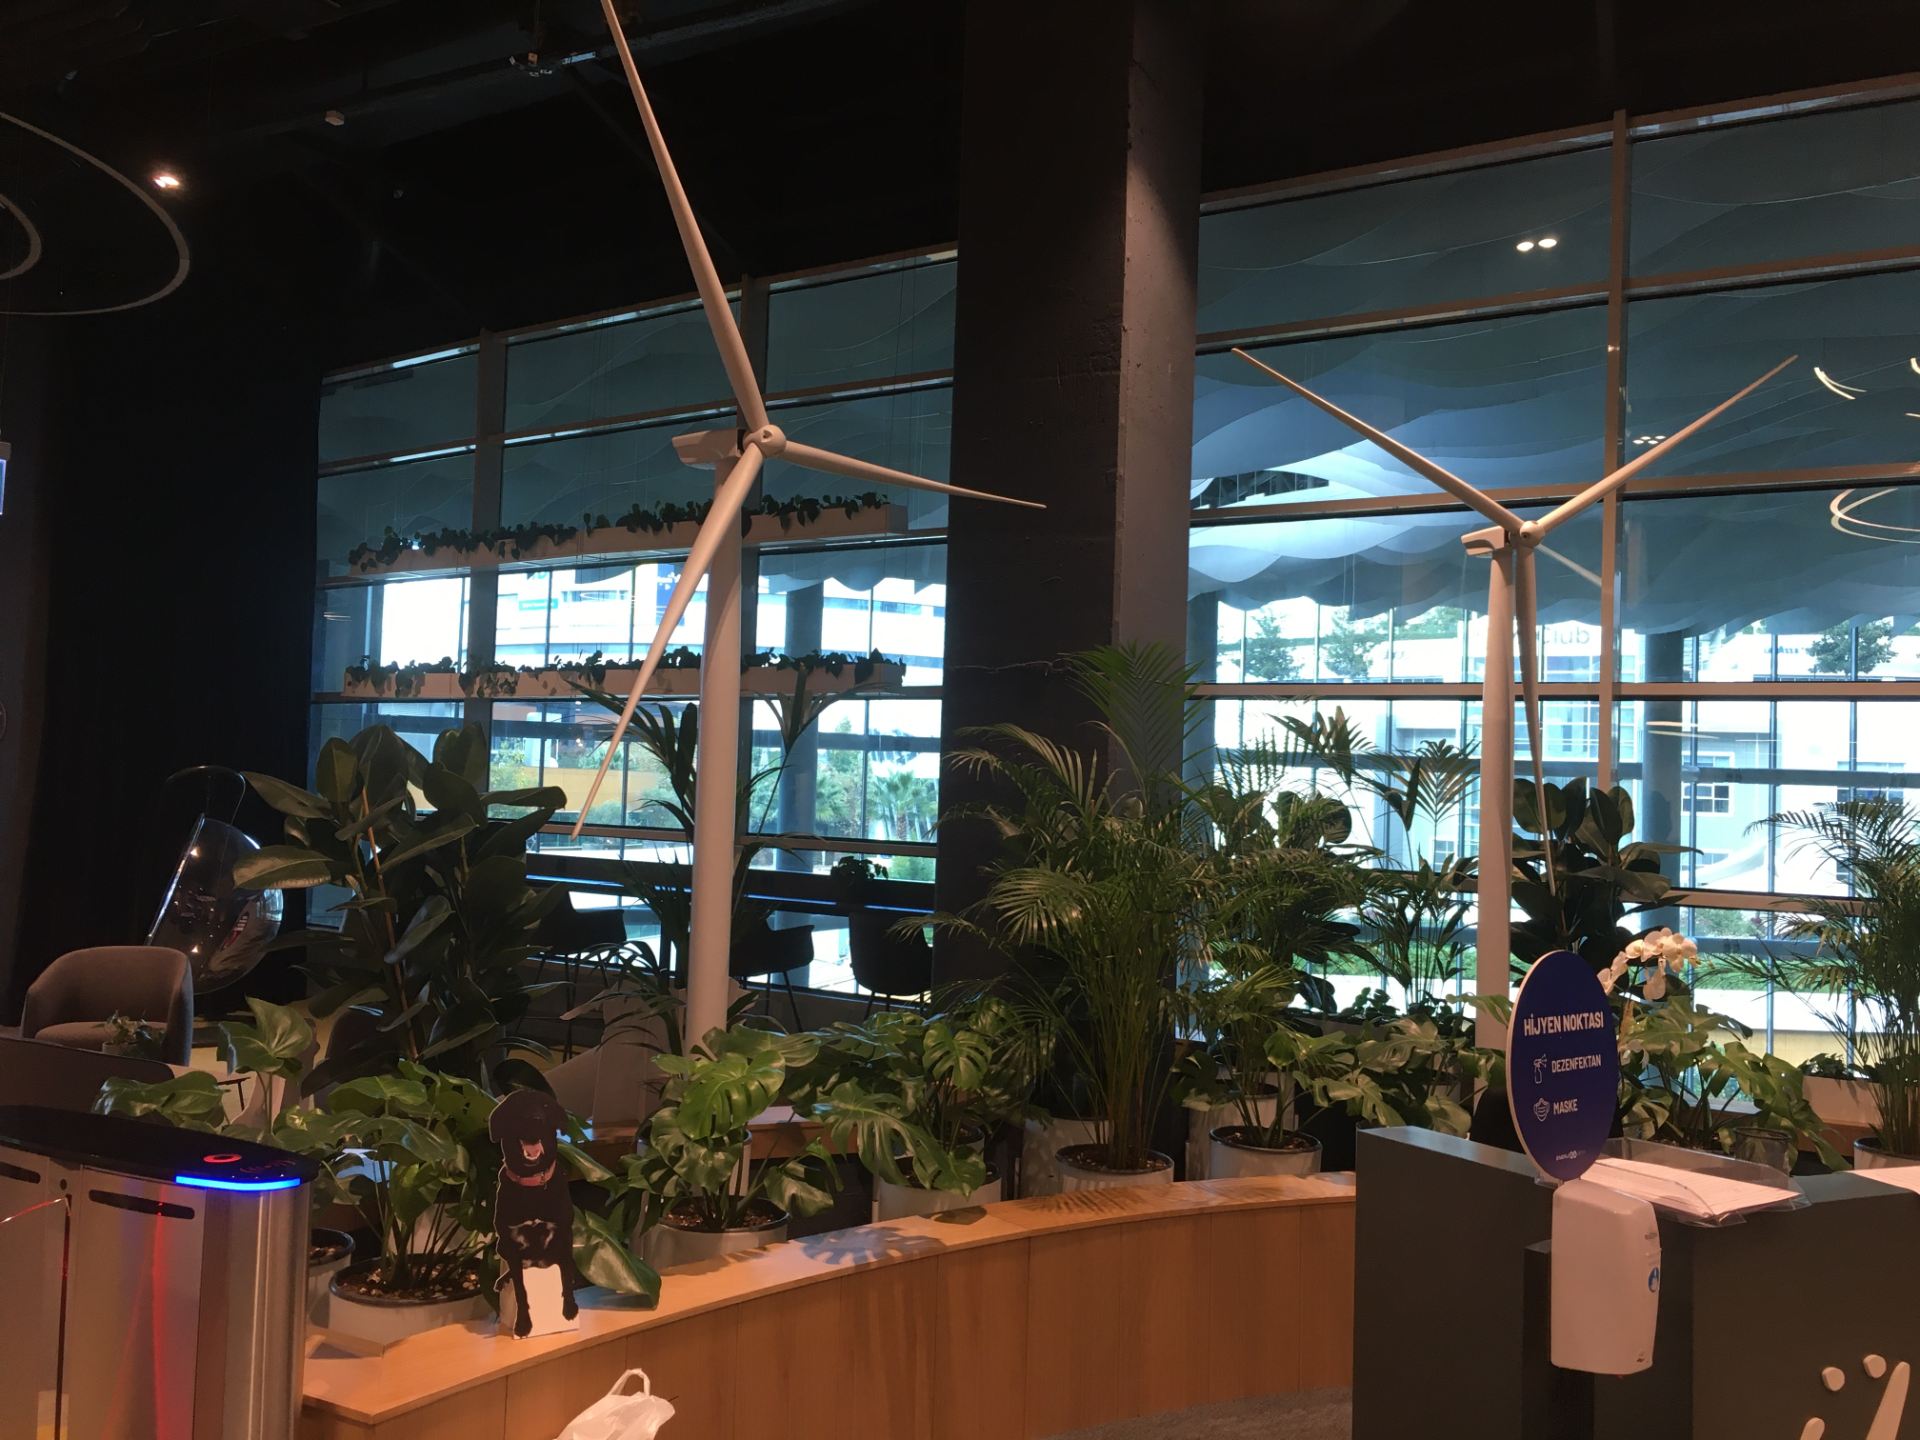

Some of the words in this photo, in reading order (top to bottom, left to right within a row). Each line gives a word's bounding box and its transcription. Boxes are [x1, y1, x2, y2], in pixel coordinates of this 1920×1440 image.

[1523, 1013, 1562, 1037] HİJYEN
[1563, 1011, 1604, 1033] NOKTASI
[1551, 1054, 1602, 1073] DEZENFEKTAN
[1553, 1098, 1579, 1115] MASKE
